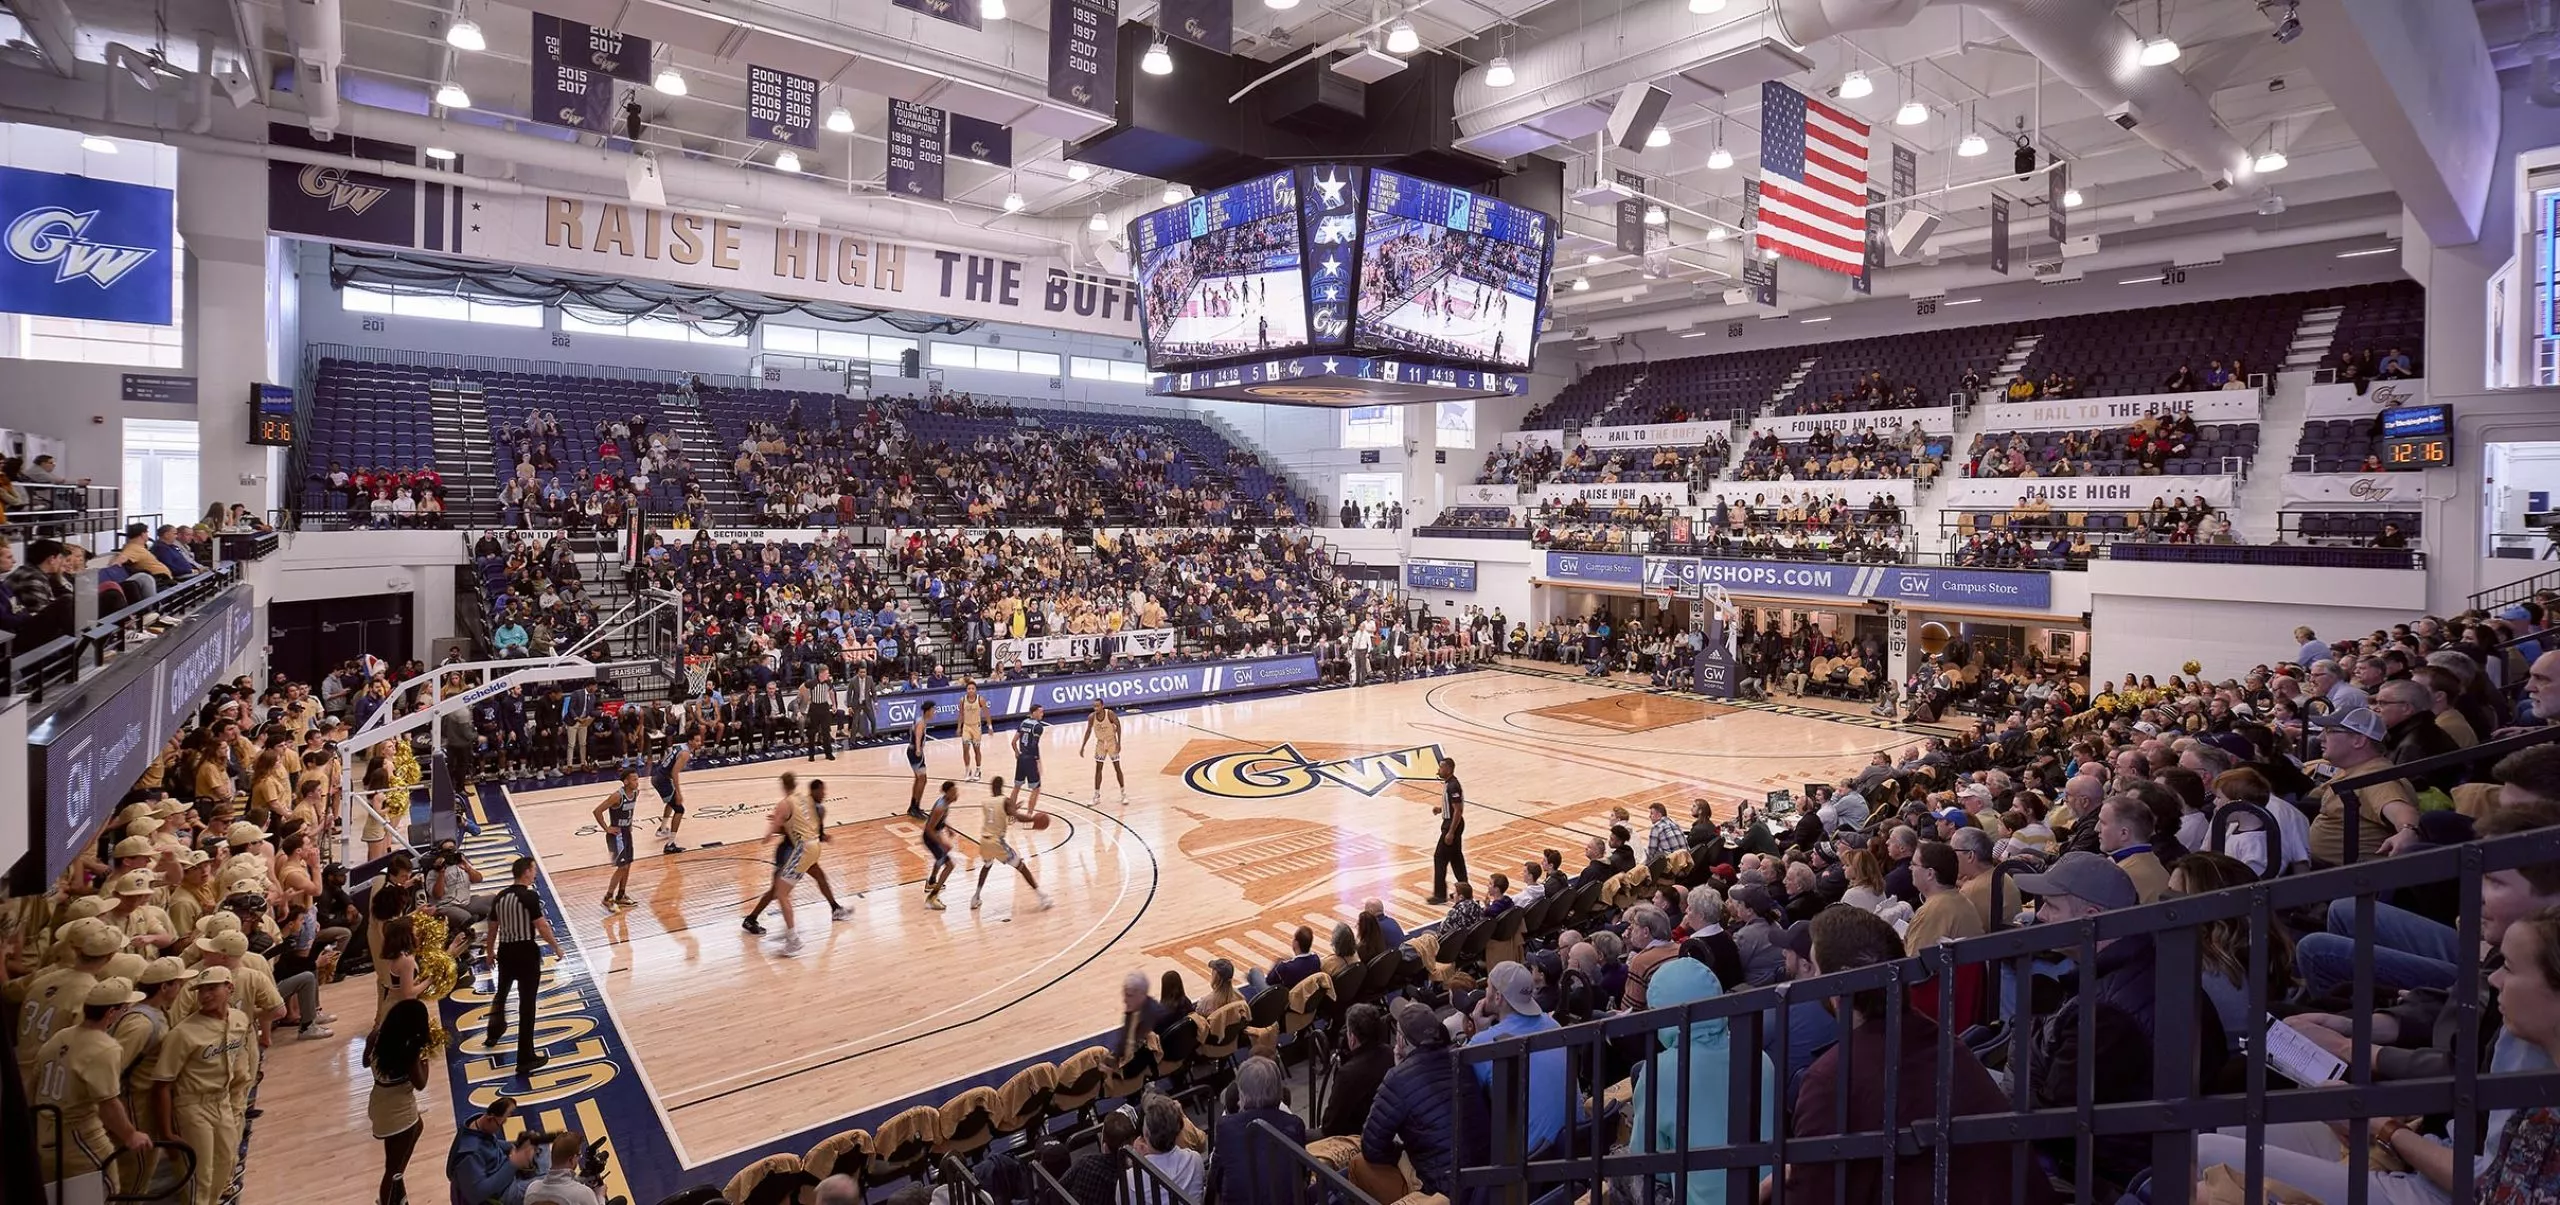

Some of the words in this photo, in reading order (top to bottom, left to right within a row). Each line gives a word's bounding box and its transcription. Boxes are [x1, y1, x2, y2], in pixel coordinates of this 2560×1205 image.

[1073, 7, 1097, 26] 1995
[1073, 23, 1097, 41] 1997
[590, 36, 622, 55] 2017
[1071, 39, 1097, 58] 2007
[1069, 55, 1097, 74] 2008
[558, 66, 588, 82] 2015
[752, 68, 782, 85] 2004
[786, 76, 815, 93] 2008
[558, 80, 586, 95] 2017
[752, 81, 782, 98] 2005
[786, 89, 812, 105] 2015
[752, 94, 781, 110] 2006
[786, 102, 811, 117] 2016
[895, 100, 930, 116] ATLANTIC
[931, 109, 940, 118] 10
[751, 107, 781, 122] 2007
[785, 114, 811, 129] 2017
[893, 108, 941, 127] TOURNAMENT
[896, 117, 938, 134] CHAMPIONS
[891, 131, 913, 145] 1998
[919, 138, 940, 151] 2001
[891, 144, 913, 158] 1999
[919, 151, 942, 165] 2002
[890, 157, 915, 171] 2000
[4, 205, 157, 290] GW
[545, 195, 742, 271] RAISE
[774, 228, 907, 293] HIGH
[935, 250, 1021, 307] THE
[2161, 271, 2186, 285] 210
[1917, 304, 1936, 315] 209
[362, 320, 385, 331] 201
[1313, 308, 1348, 338] GW
[1728, 327, 1743, 338] 208
[552, 336, 570, 347] 202
[765, 372, 781, 381] 203
[1200, 373, 1210, 387] 11
[1218, 369, 1239, 381] 14:19
[1252, 367, 1259, 381] 5
[1409, 368, 1421, 382] 11
[1432, 369, 1455, 382] 14:19
[1468, 374, 1475, 387] 5
[2034, 405, 2071, 421] HAIL
[2079, 404, 2099, 419] TO
[2108, 403, 2141, 418] THE
[262, 421, 291, 441] 12:16
[1792, 418, 1847, 432] FOUNDED
[1853, 418, 1867, 430] IN
[1874, 416, 1903, 429] 1821
[1608, 431, 1631, 442] HAIL
[1634, 430, 1646, 441] TO
[1650, 429, 1669, 440] THE
[1672, 427, 1697, 439] BUFF
[2393, 441, 2444, 462] 12:16
[1580, 488, 1608, 499] RAISE
[1611, 488, 1636, 500] HIGH
[2026, 484, 2077, 499] RAISE
[2086, 484, 2131, 500] HIGH
[2350, 478, 2393, 502] GW
[537, 531, 553, 539] 101
[750, 530, 764, 538] 102
[1559, 558, 1578, 571] GW
[1585, 562, 1612, 573] Campus
[1614, 563, 1631, 573] Store
[1432, 578, 1448, 587] 14:19
[1460, 579, 1465, 588] 5
[1683, 564, 1832, 588] GWSHOPS.COM
[1900, 575, 1930, 592] GW
[1942, 580, 1986, 594] Campus
[1988, 583, 2018, 594] Store
[1890, 619, 1907, 630] 108
[1093, 635, 1128, 656] AMY
[1890, 641, 1906, 652] 107
[1234, 669, 1252, 683] GW
[1260, 668, 1285, 678] Campus
[1286, 667, 1302, 676] Store
[1704, 667, 1725, 681] GW
[462, 681, 508, 704] Schelde
[1052, 674, 1189, 704] GWSHOPS.COM
[888, 705, 916, 722] GW
[1022, 734, 1029, 746] 4
[1181, 742, 1447, 799] GW
[22, 1000, 54, 1042] 34
[40, 1060, 66, 1101] 10
